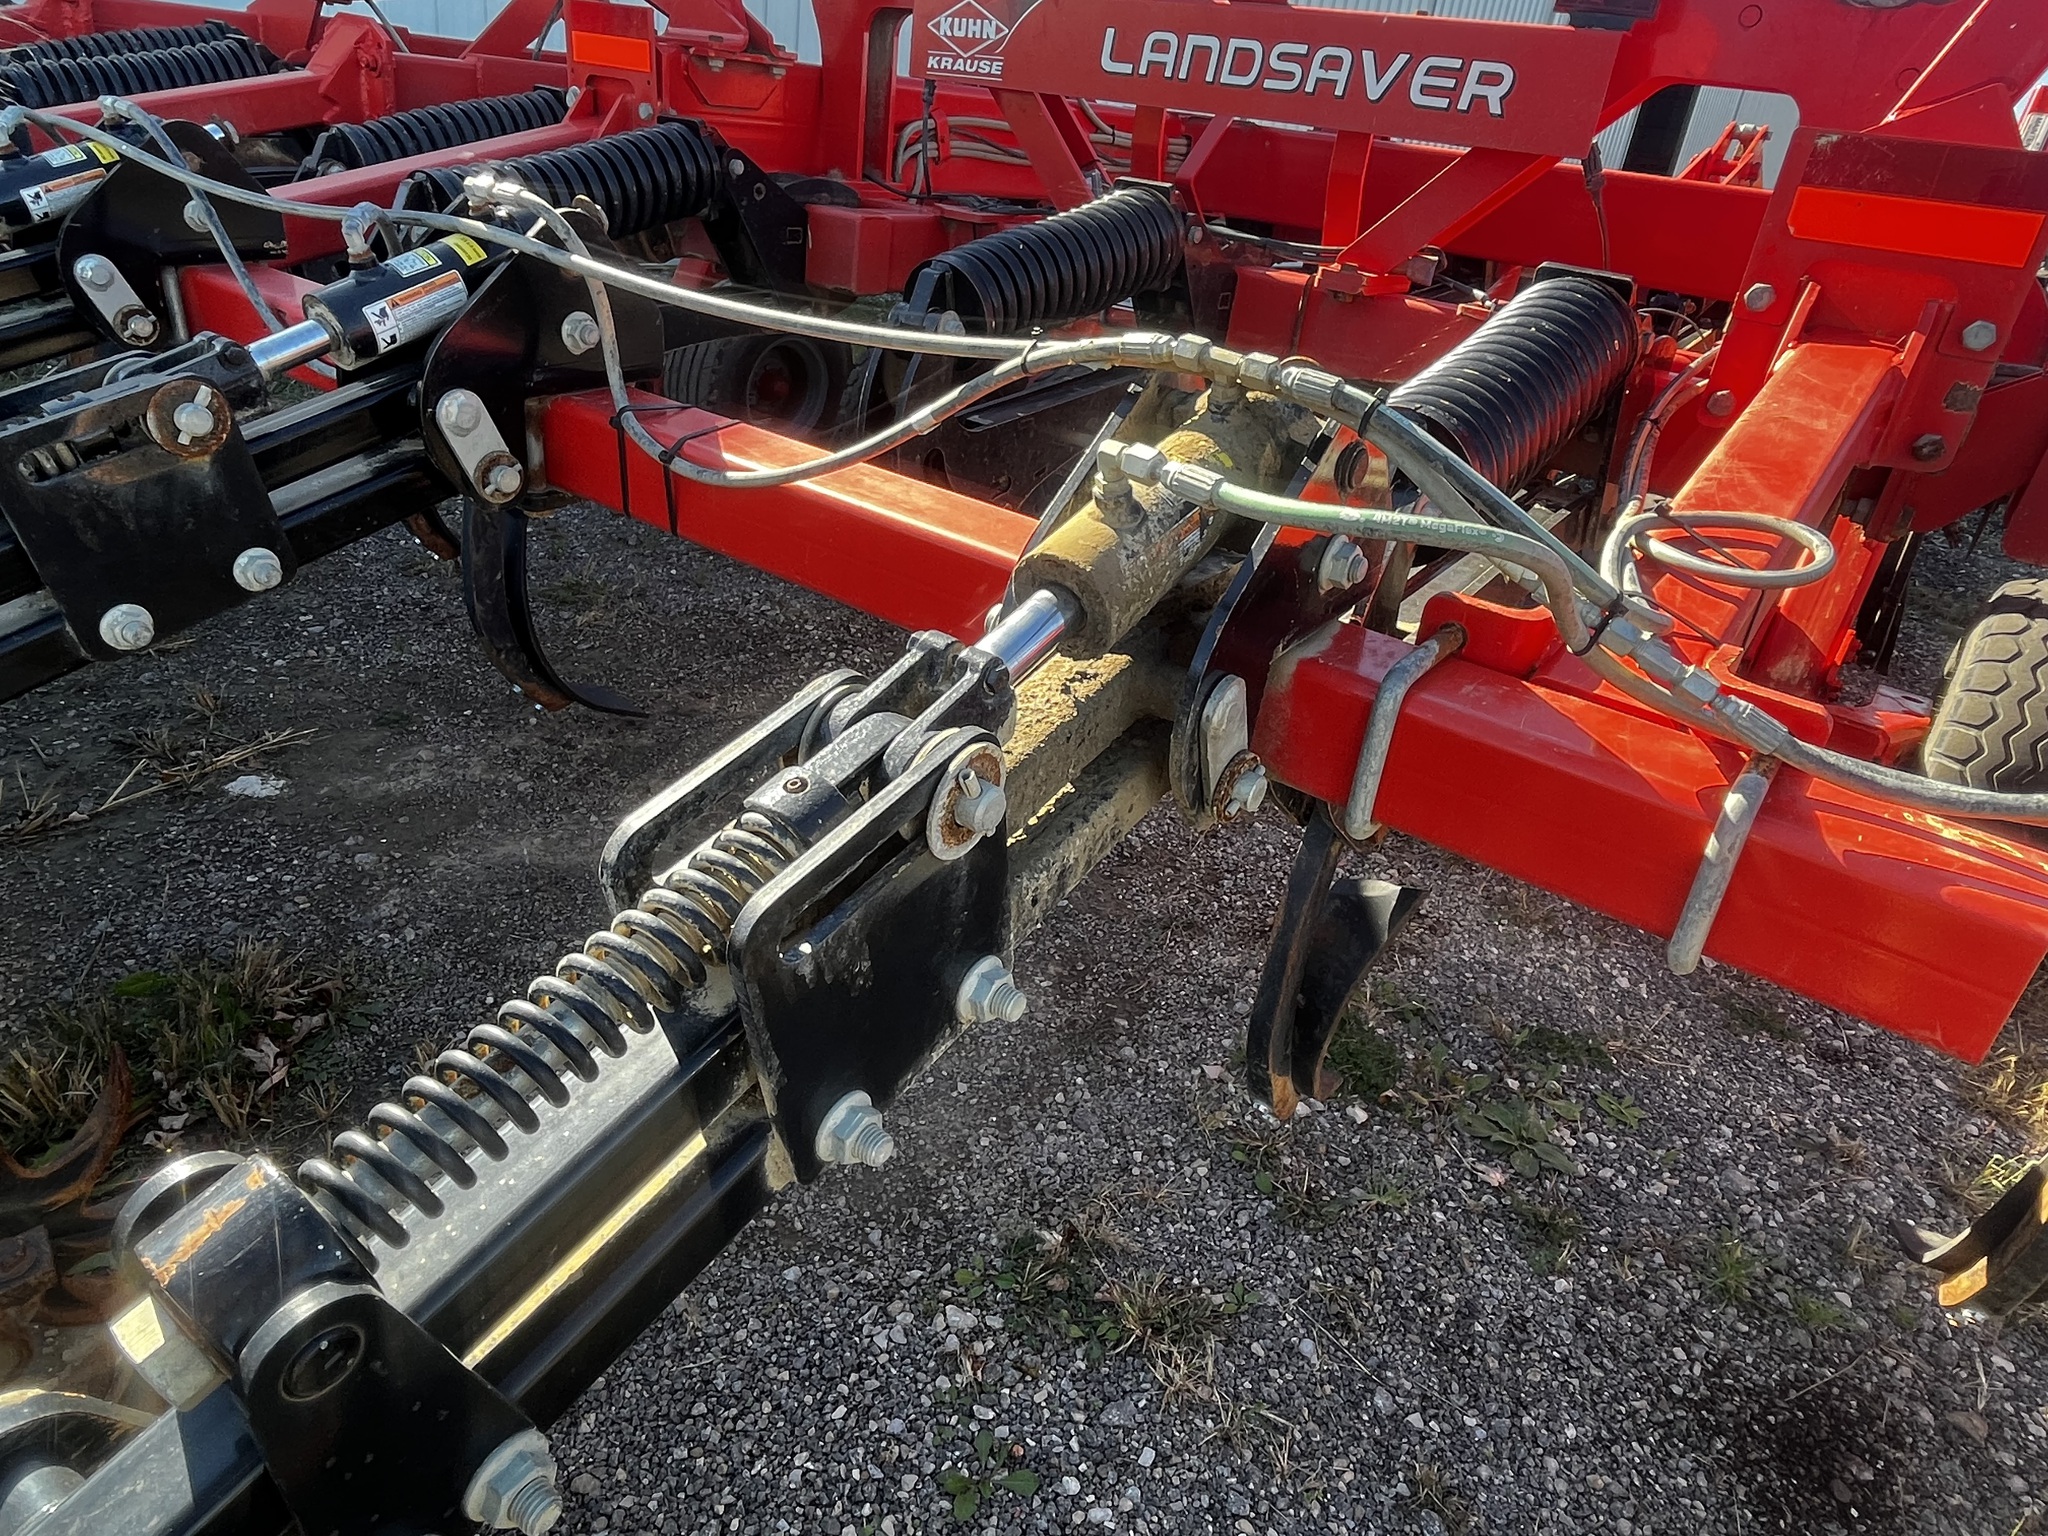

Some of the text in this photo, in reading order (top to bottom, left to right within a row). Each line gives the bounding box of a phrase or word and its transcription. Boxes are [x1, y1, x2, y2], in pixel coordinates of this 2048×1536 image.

[940, 17, 996, 39] KUHN
[927, 56, 1003, 75] KRAUSE
[1100, 27, 1515, 117] LANDSAVER
